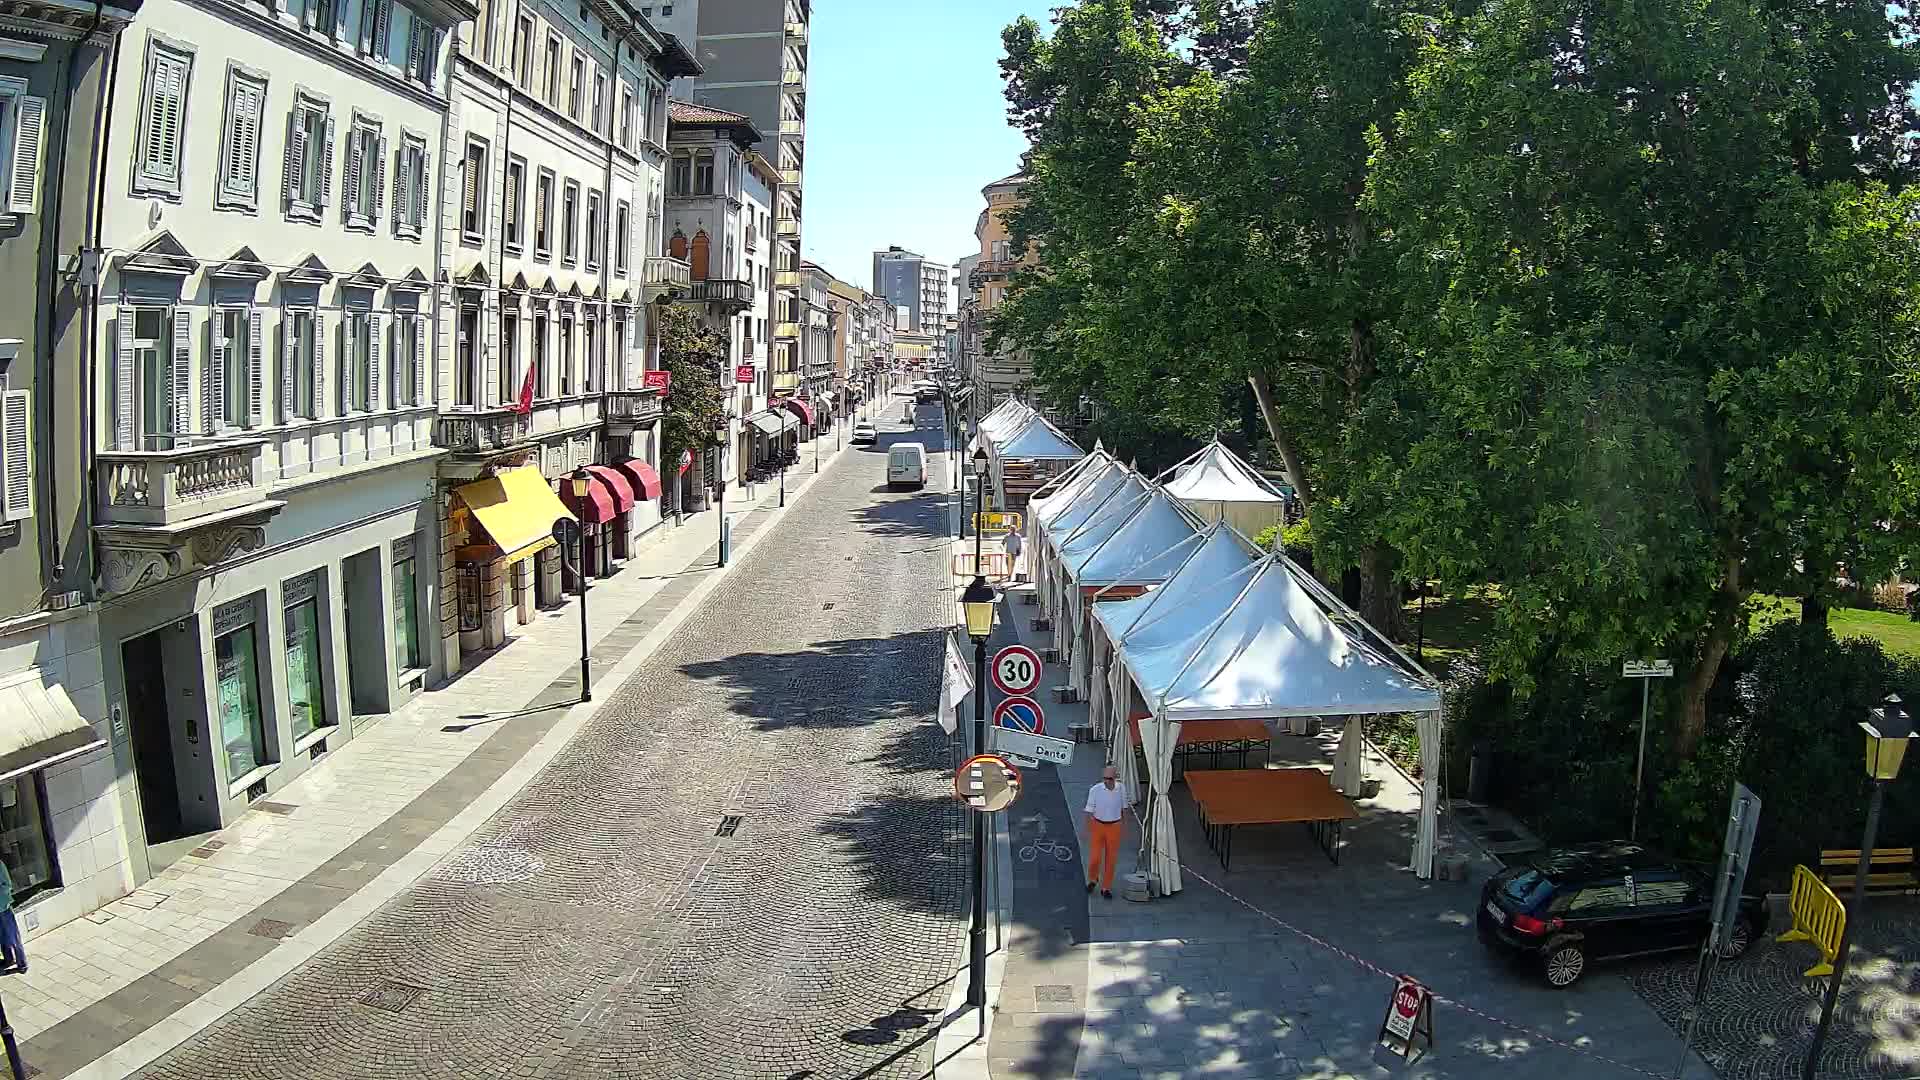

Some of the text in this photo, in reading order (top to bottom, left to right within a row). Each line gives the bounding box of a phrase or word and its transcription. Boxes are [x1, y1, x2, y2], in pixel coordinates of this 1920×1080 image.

[1003, 660, 1031, 682] 30
[1036, 746, 1066, 760] Dante
[1398, 991, 1419, 1012] STOP
